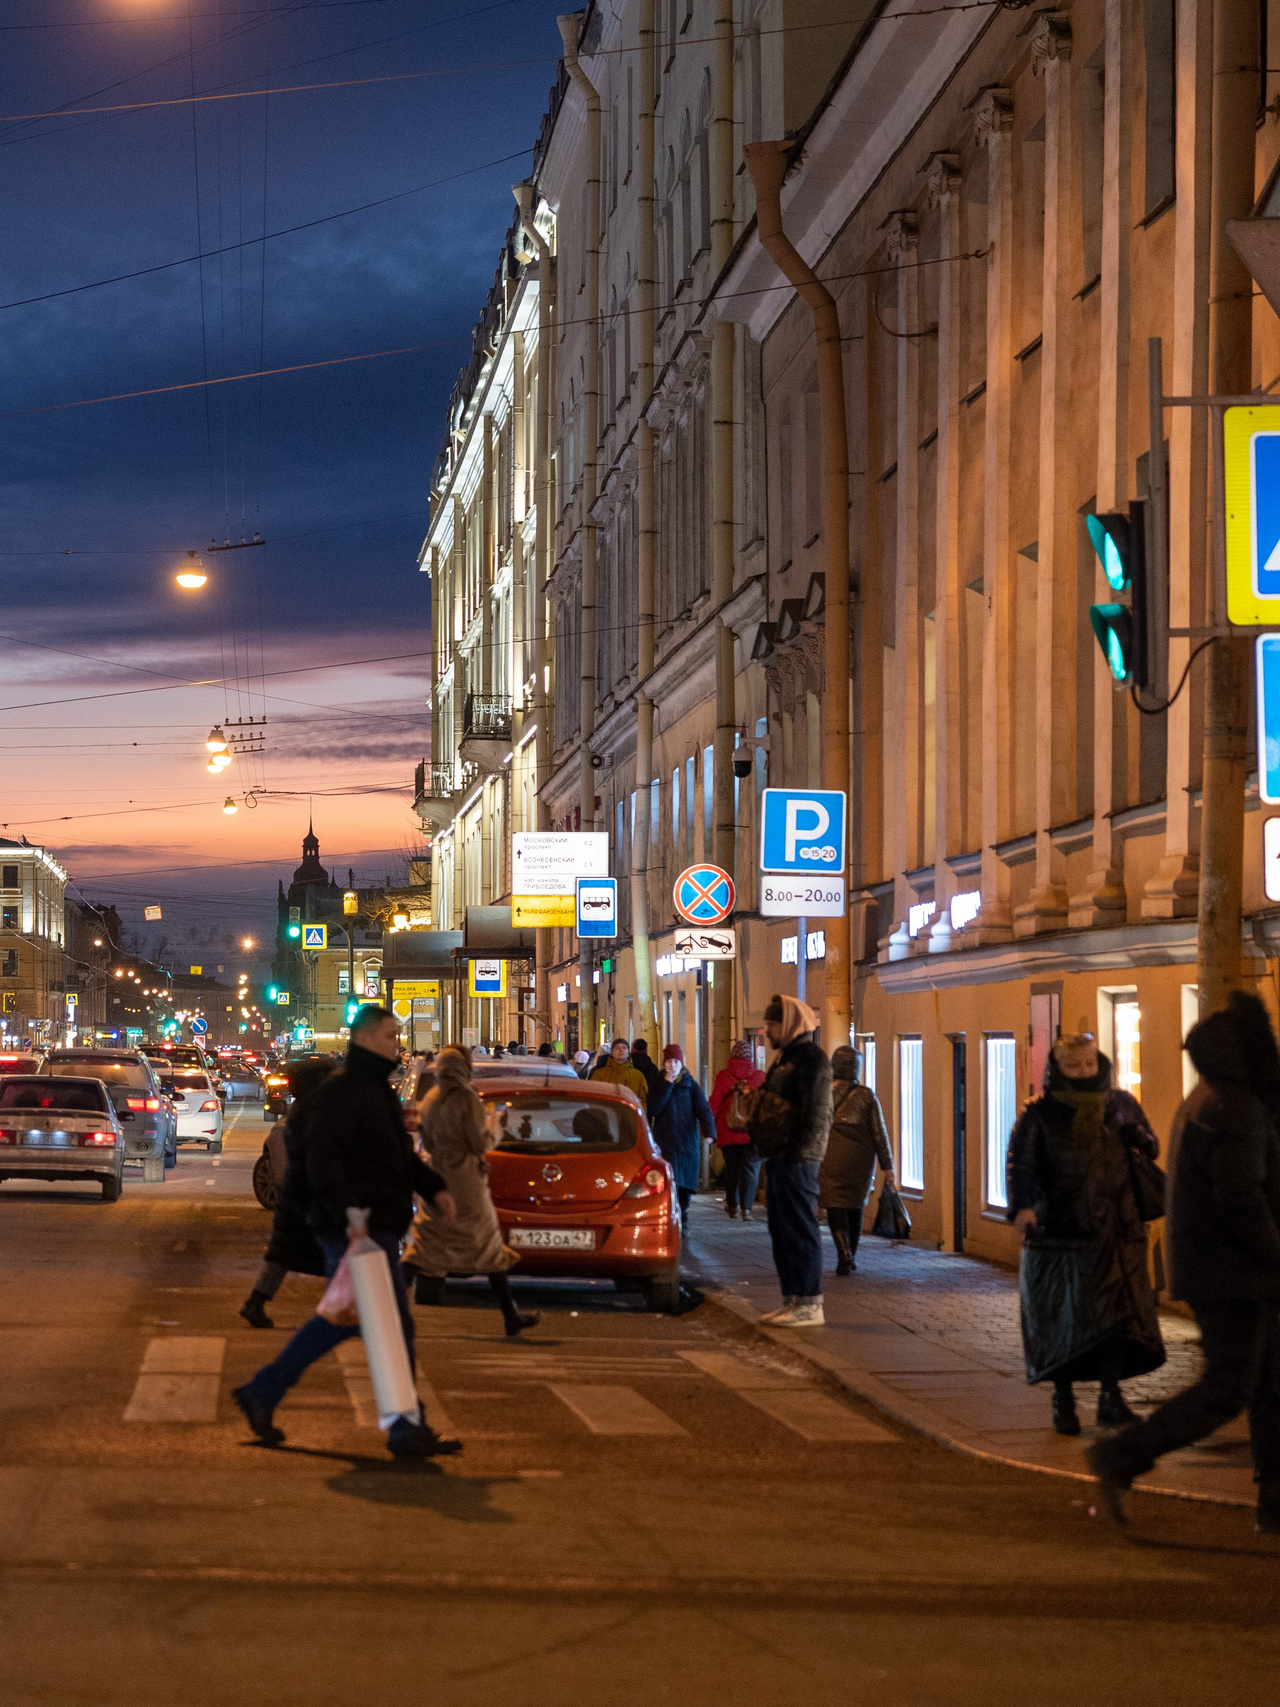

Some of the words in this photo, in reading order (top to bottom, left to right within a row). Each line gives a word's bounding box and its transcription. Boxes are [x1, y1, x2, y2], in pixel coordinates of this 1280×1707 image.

[785, 800, 829, 862] P
[811, 849, 820, 858] 15
[822, 849, 836, 859] 20
[523, 907, 575, 915] РАЙФФАЙЗЕНБАНК
